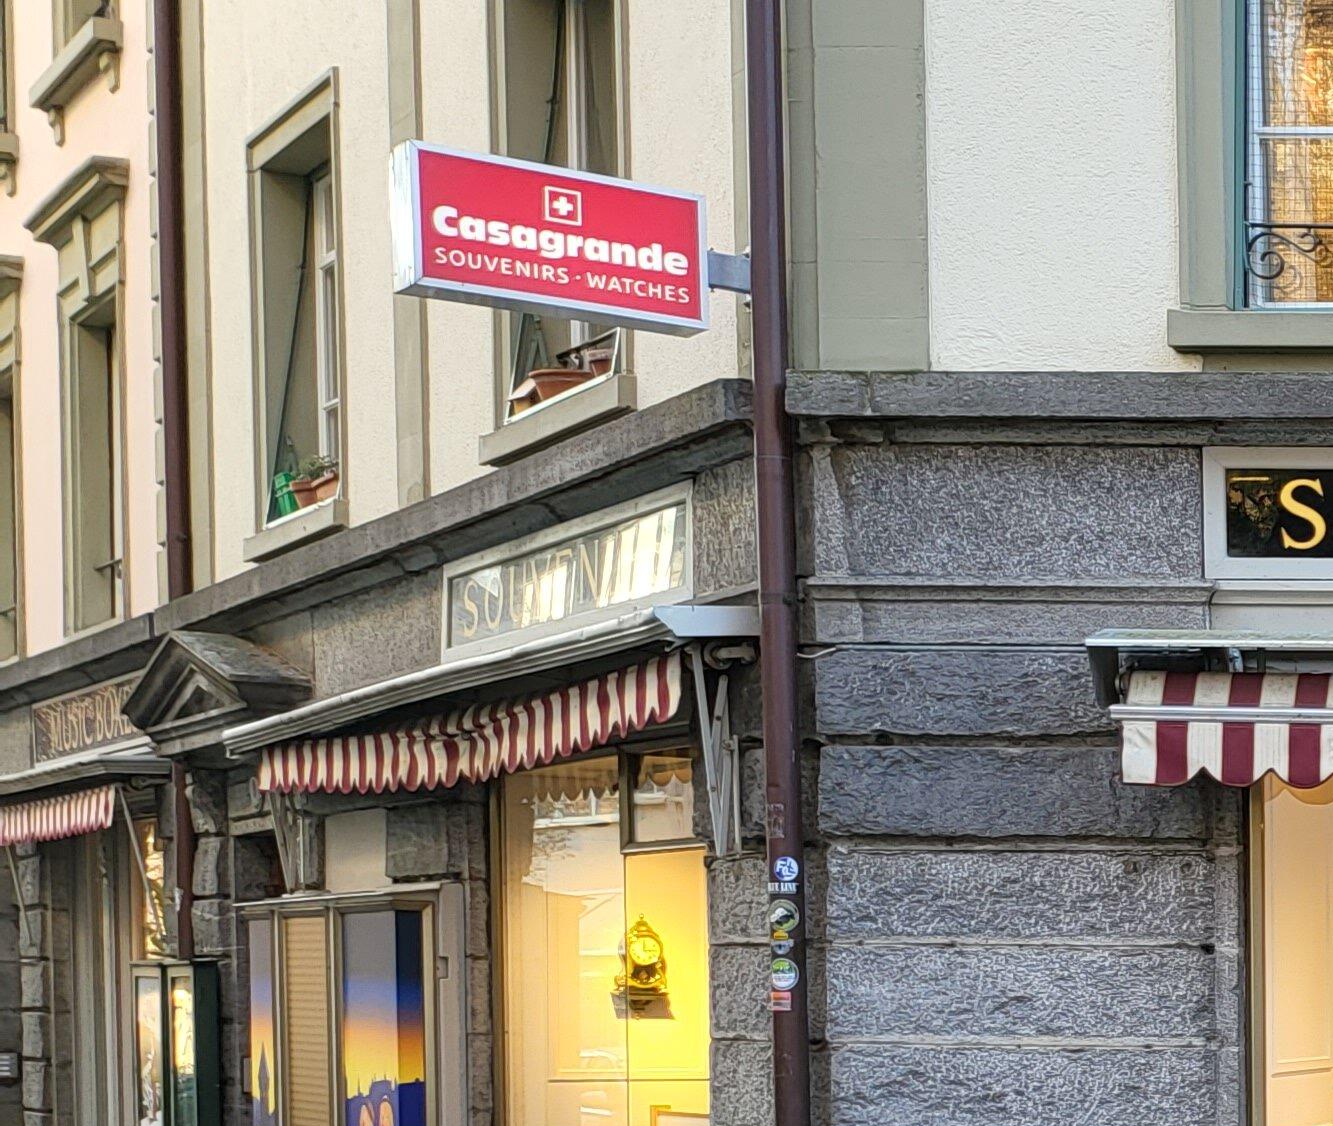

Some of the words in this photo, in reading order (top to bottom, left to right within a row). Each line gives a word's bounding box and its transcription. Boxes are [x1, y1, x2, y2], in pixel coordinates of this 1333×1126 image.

[432, 205, 689, 276] Casagrande
[435, 247, 569, 285] SOUVENIRS
[586, 271, 690, 303] WATCHES
